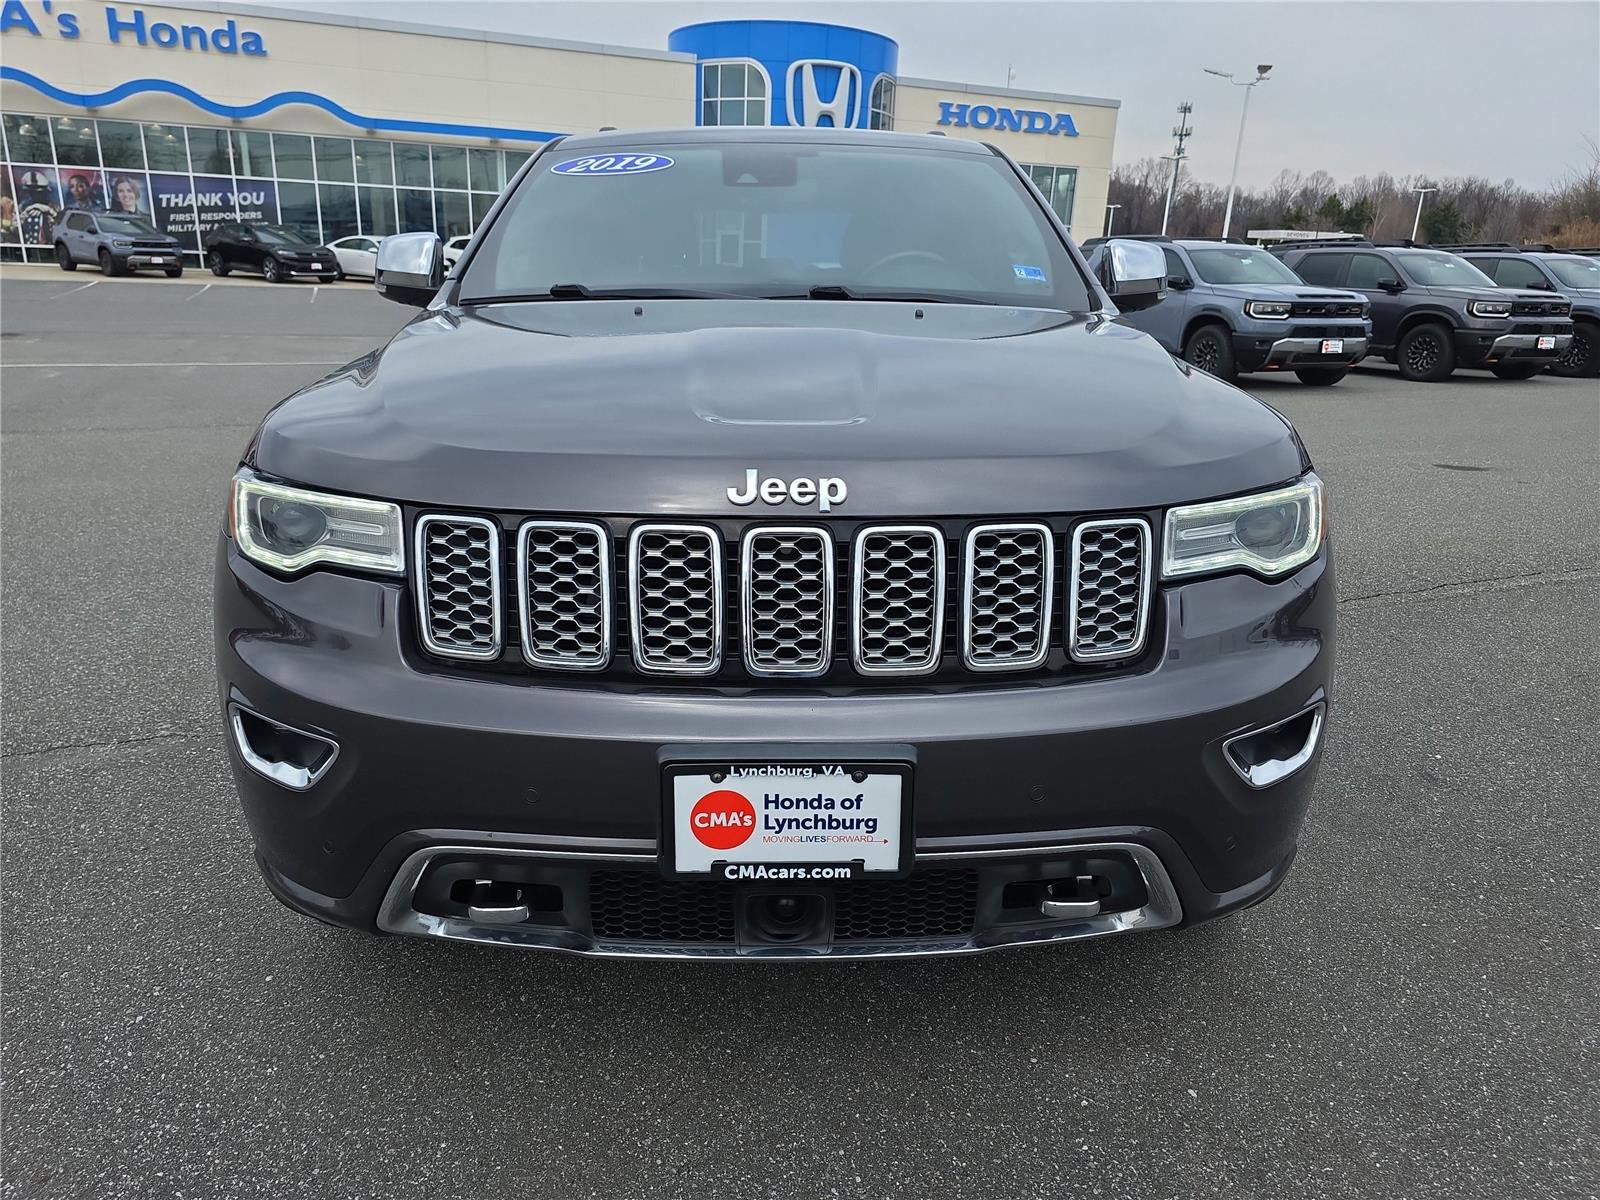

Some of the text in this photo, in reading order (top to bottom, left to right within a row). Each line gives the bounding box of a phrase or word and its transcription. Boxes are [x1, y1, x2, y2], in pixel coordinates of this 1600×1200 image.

[105, 7, 267, 56] Honda
[937, 101, 1079, 137] HONDA
[566, 156, 657, 172] 2019
[159, 191, 265, 208] THANK YOU
[170, 211, 262, 221] FIRST RESPONDERS
[167, 223, 213, 232] MILITARY
[727, 468, 848, 513] Jeep
[730, 765, 845, 778] Lynchburg, VA
[764, 793, 863, 810] Honda of
[694, 811, 753, 828] CMA's
[764, 814, 878, 833] Lynchburg
[763, 835, 874, 843] MOVINGLIVESFORWARD
[724, 865, 851, 879] CMAcars.com
